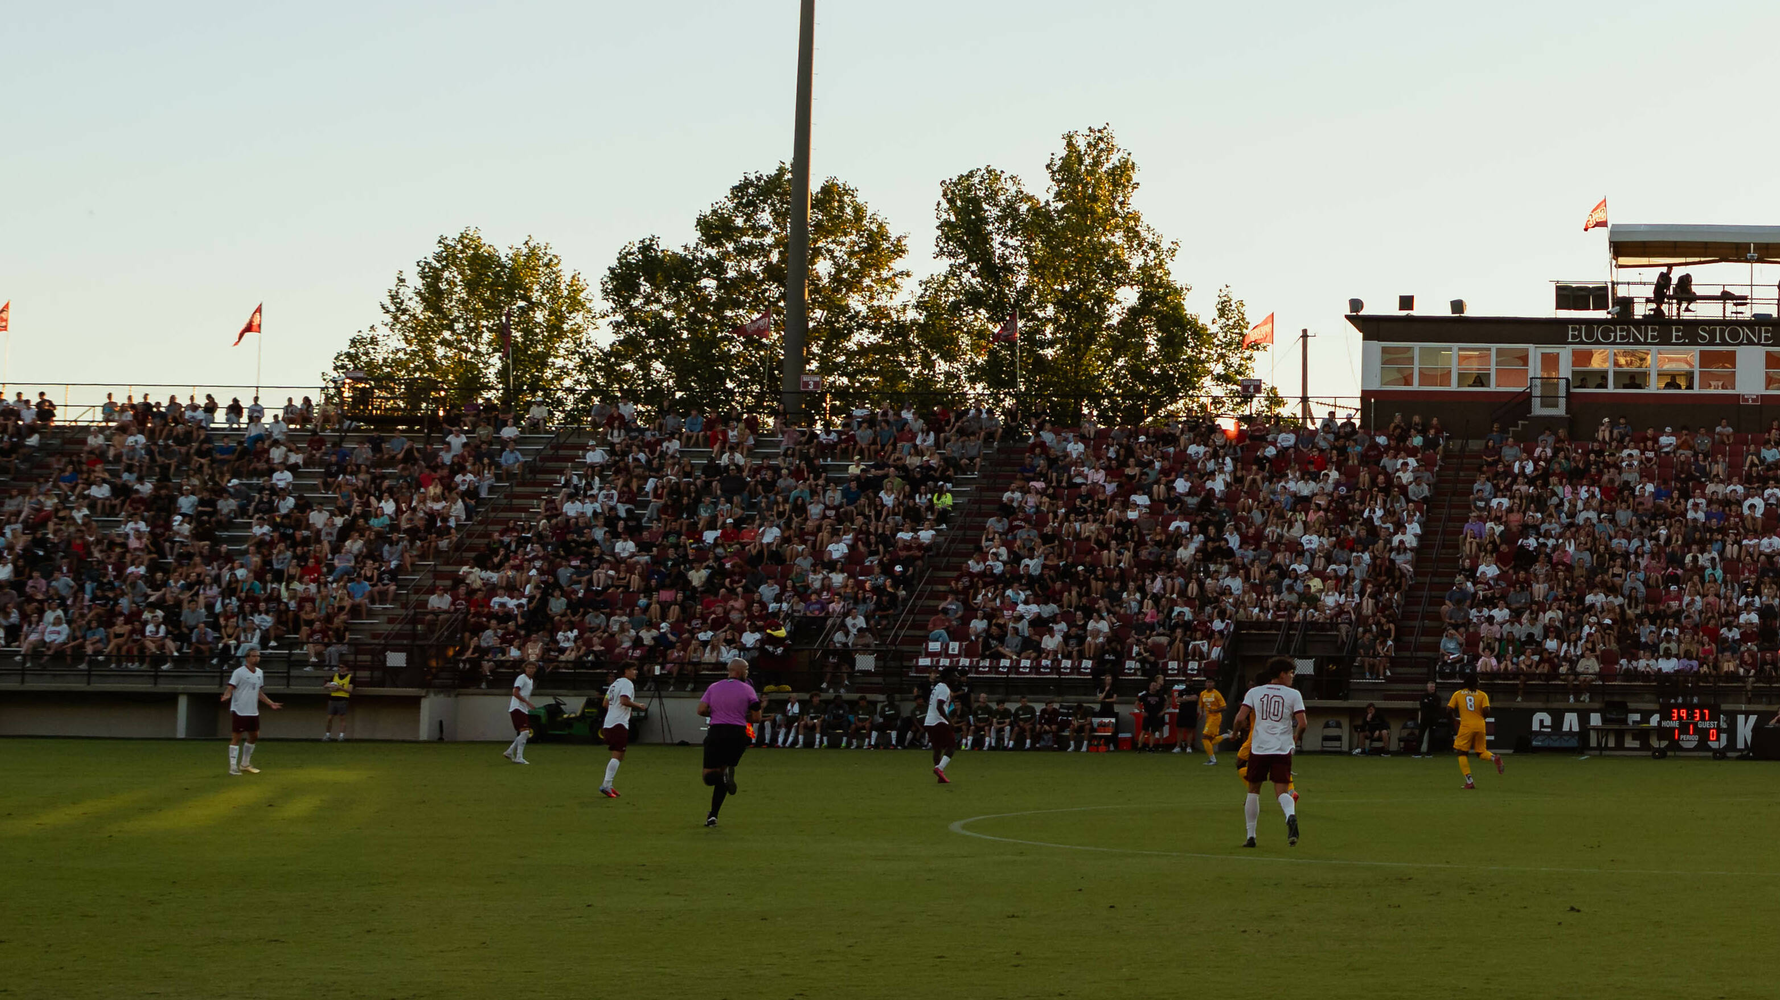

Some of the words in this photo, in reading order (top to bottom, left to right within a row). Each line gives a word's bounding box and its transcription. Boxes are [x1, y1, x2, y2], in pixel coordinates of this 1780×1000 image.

[1566, 324, 1660, 343] EUGENE
[1670, 325, 1689, 343] E.
[1696, 325, 1773, 344] STONE
[808, 381, 814, 390] 3
[1248, 385, 1255, 393] 4
[1260, 693, 1285, 722] 10
[1465, 695, 1475, 711] 8
[1661, 720, 1680, 728] HOME
[1689, 723, 1694, 735] 1
[1697, 720, 1719, 729] GUEST
[1674, 728, 1679, 741] 1
[1709, 728, 1717, 741] 0
